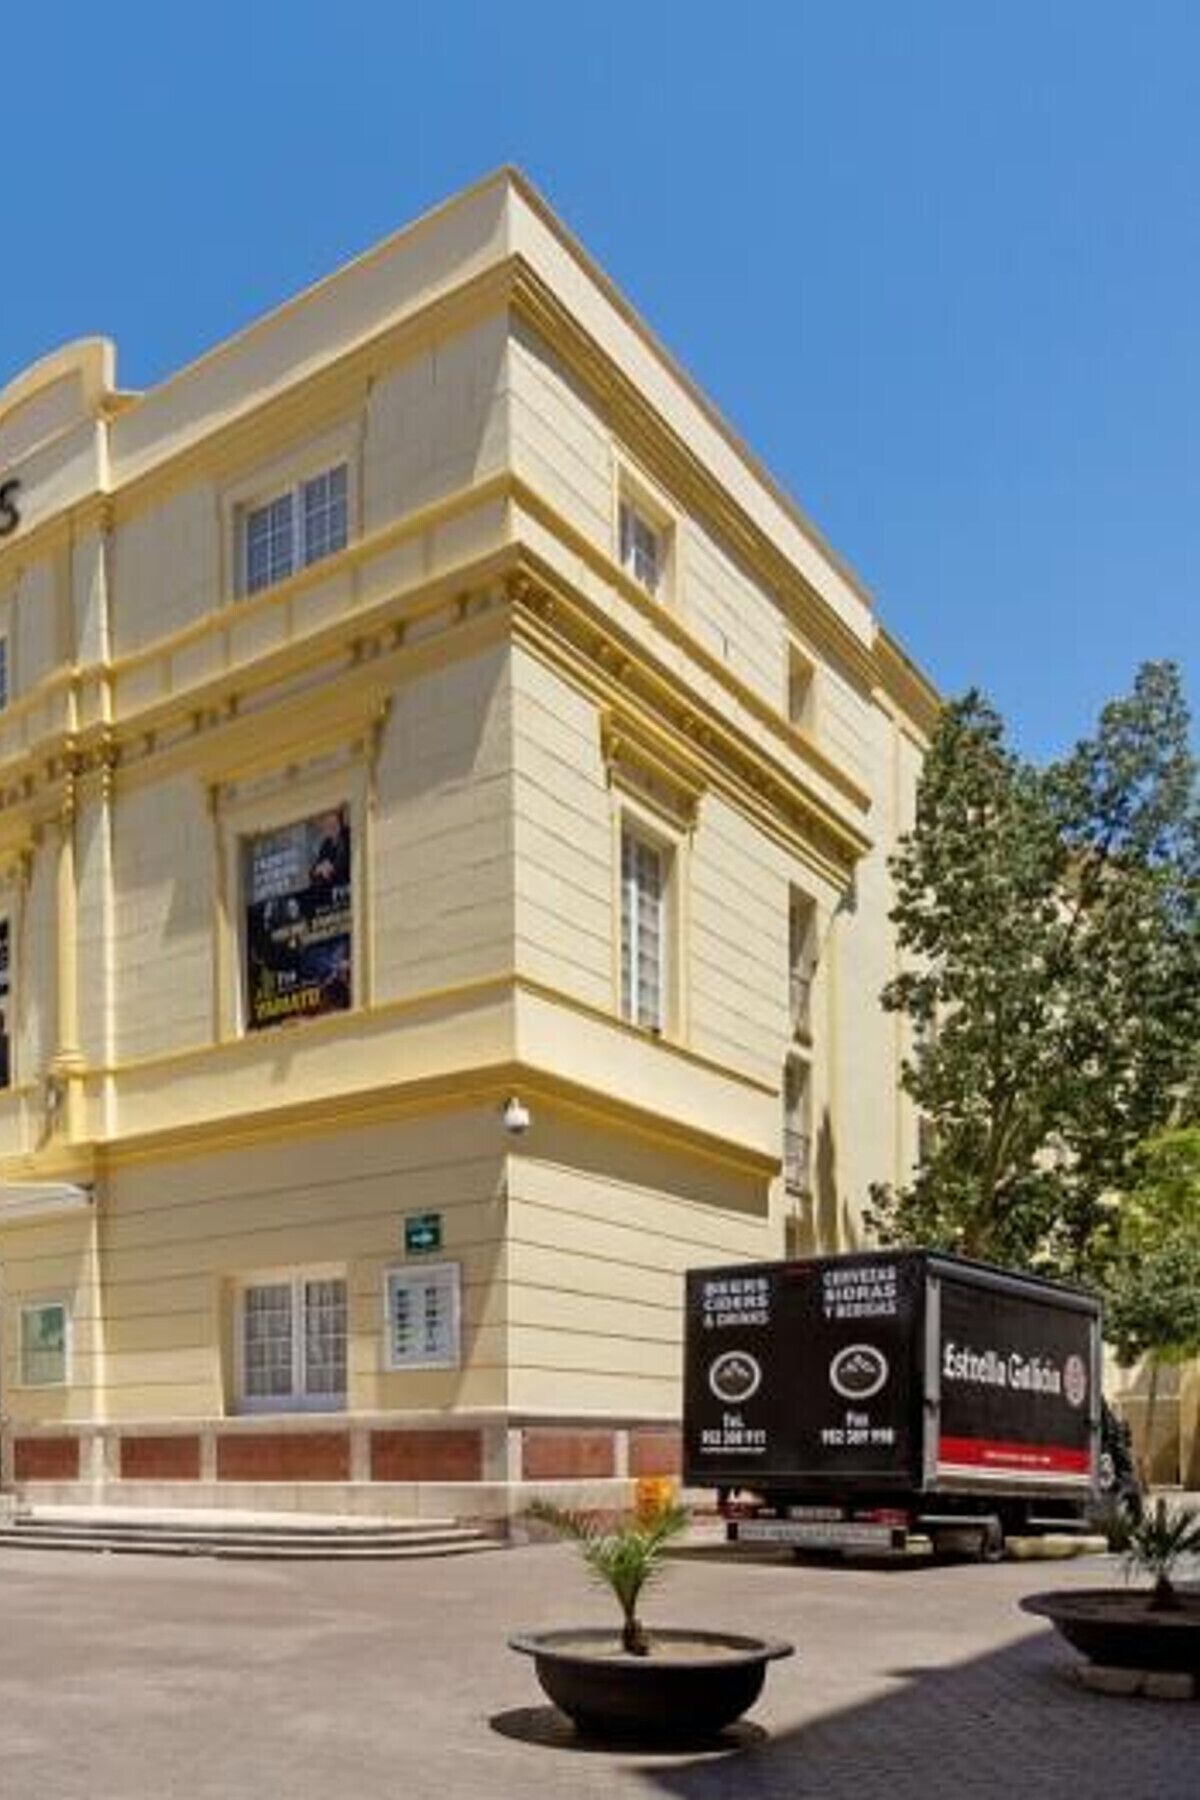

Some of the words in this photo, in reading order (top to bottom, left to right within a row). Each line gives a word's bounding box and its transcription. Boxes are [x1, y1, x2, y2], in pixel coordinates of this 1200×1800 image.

[823, 1282, 897, 1302] SIDRAS
[943, 1343, 1006, 1387] Estrella
[1008, 1352, 1061, 1395] Galicia
